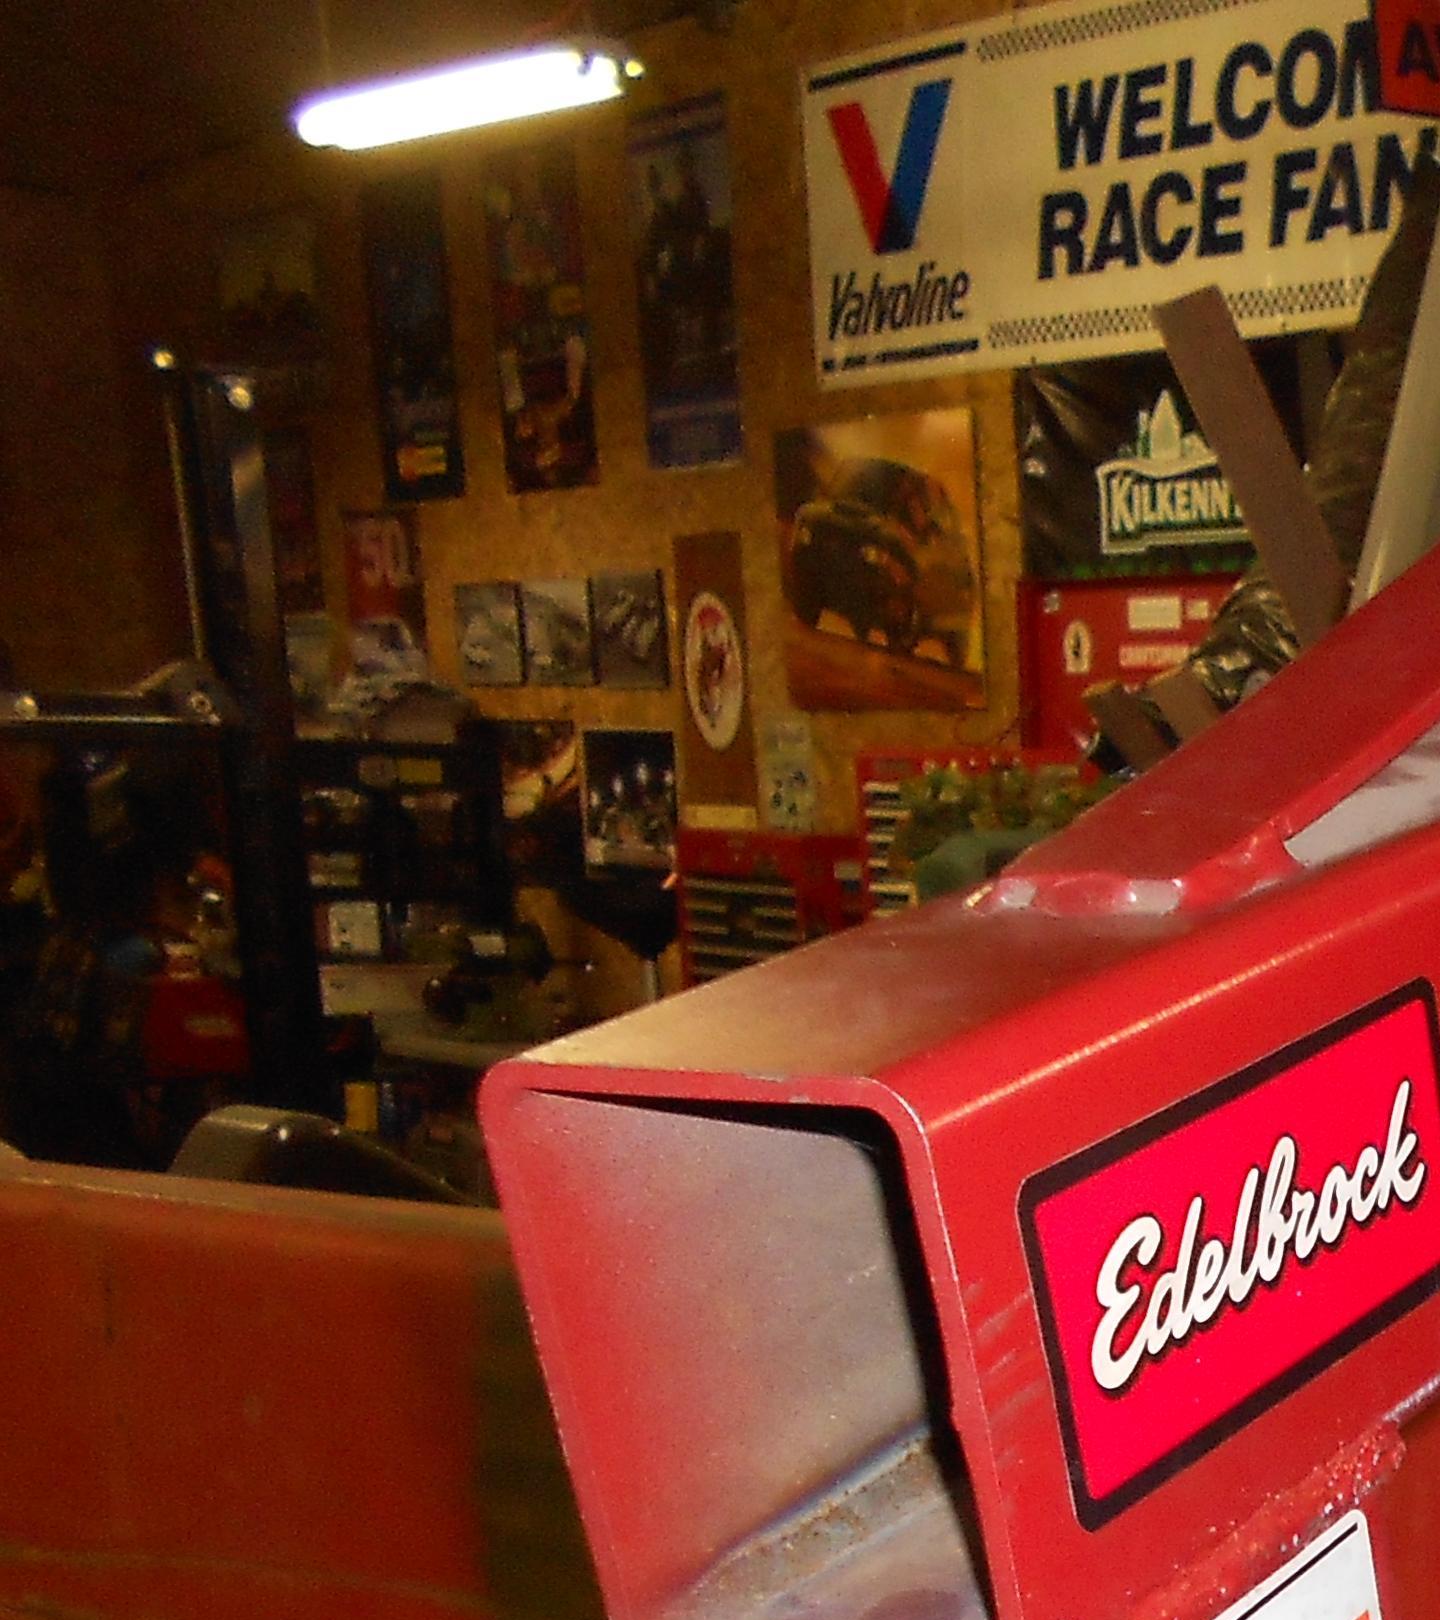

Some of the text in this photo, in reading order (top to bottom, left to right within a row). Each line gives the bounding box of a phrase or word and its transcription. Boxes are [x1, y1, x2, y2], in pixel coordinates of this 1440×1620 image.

[1053, 18, 1381, 171] WELCOM
[1038, 127, 1439, 281] RACE FAN
[828, 261, 971, 340] Valvoline
[1089, 1080, 1427, 1391] Edelbrock
